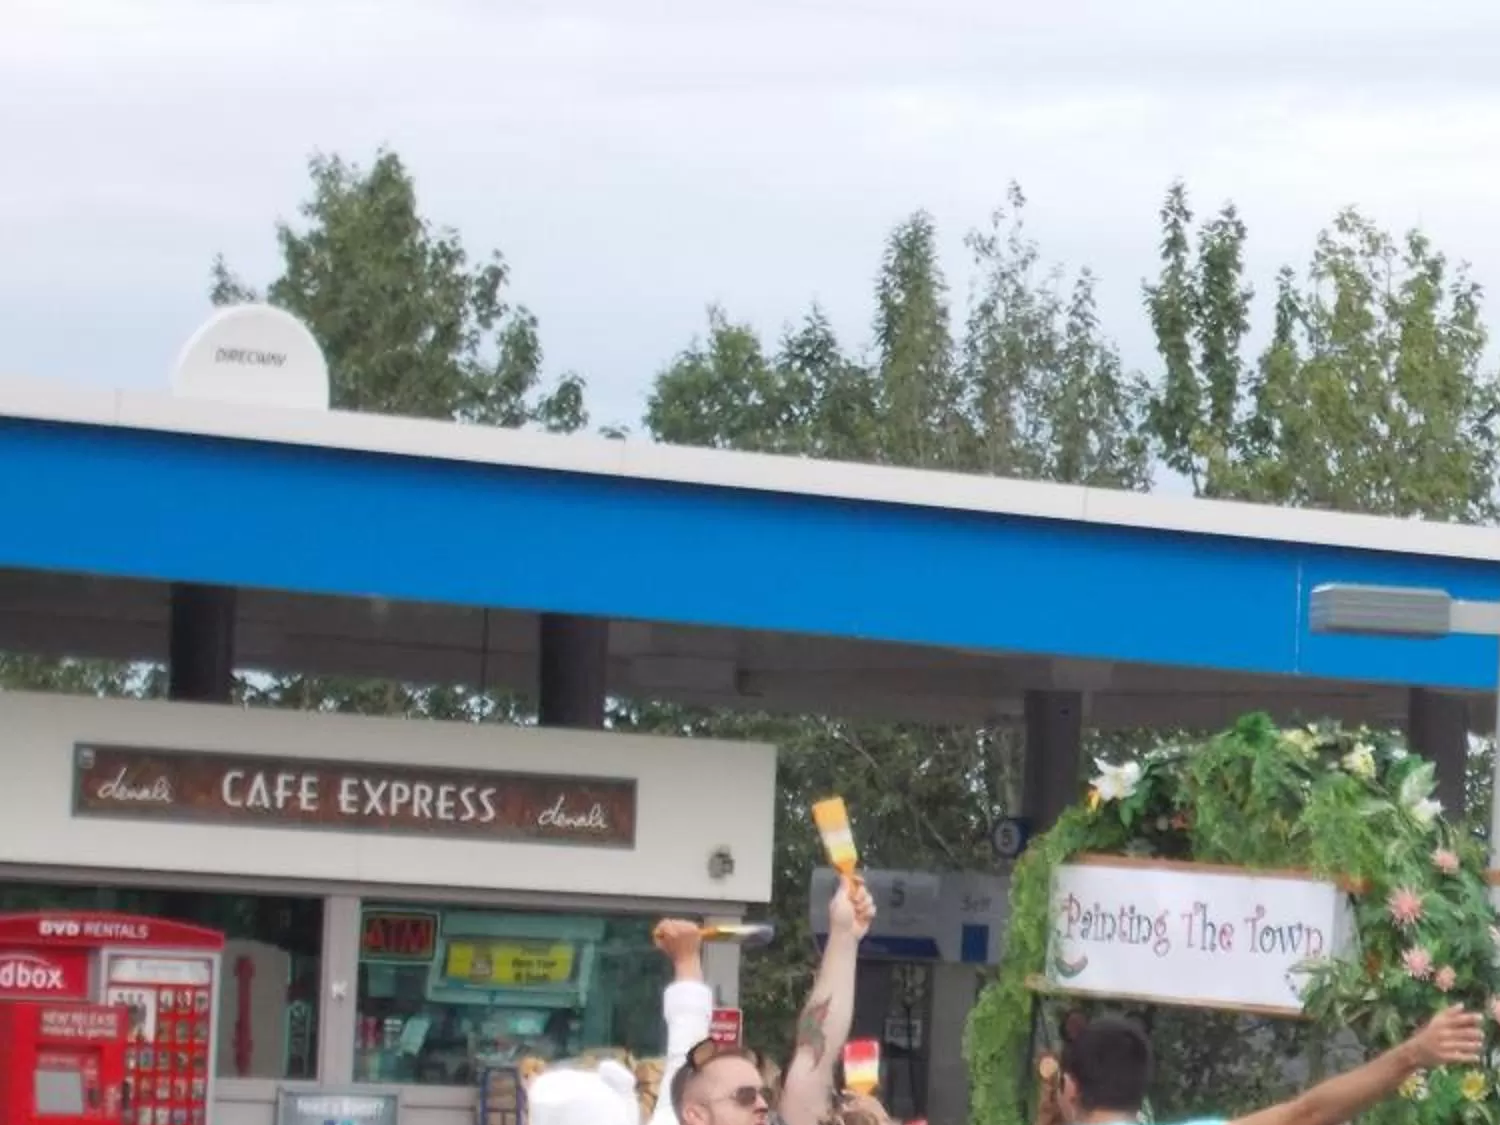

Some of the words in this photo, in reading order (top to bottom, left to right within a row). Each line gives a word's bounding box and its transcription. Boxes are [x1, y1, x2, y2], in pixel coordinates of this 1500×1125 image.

[222, 770, 319, 811] CAFE
[338, 777, 497, 822] EXPRESS
[39, 920, 80, 936] DVD
[83, 924, 149, 939] RENTALS
[1061, 892, 1170, 957] Painting
[1181, 901, 1236, 952] The
